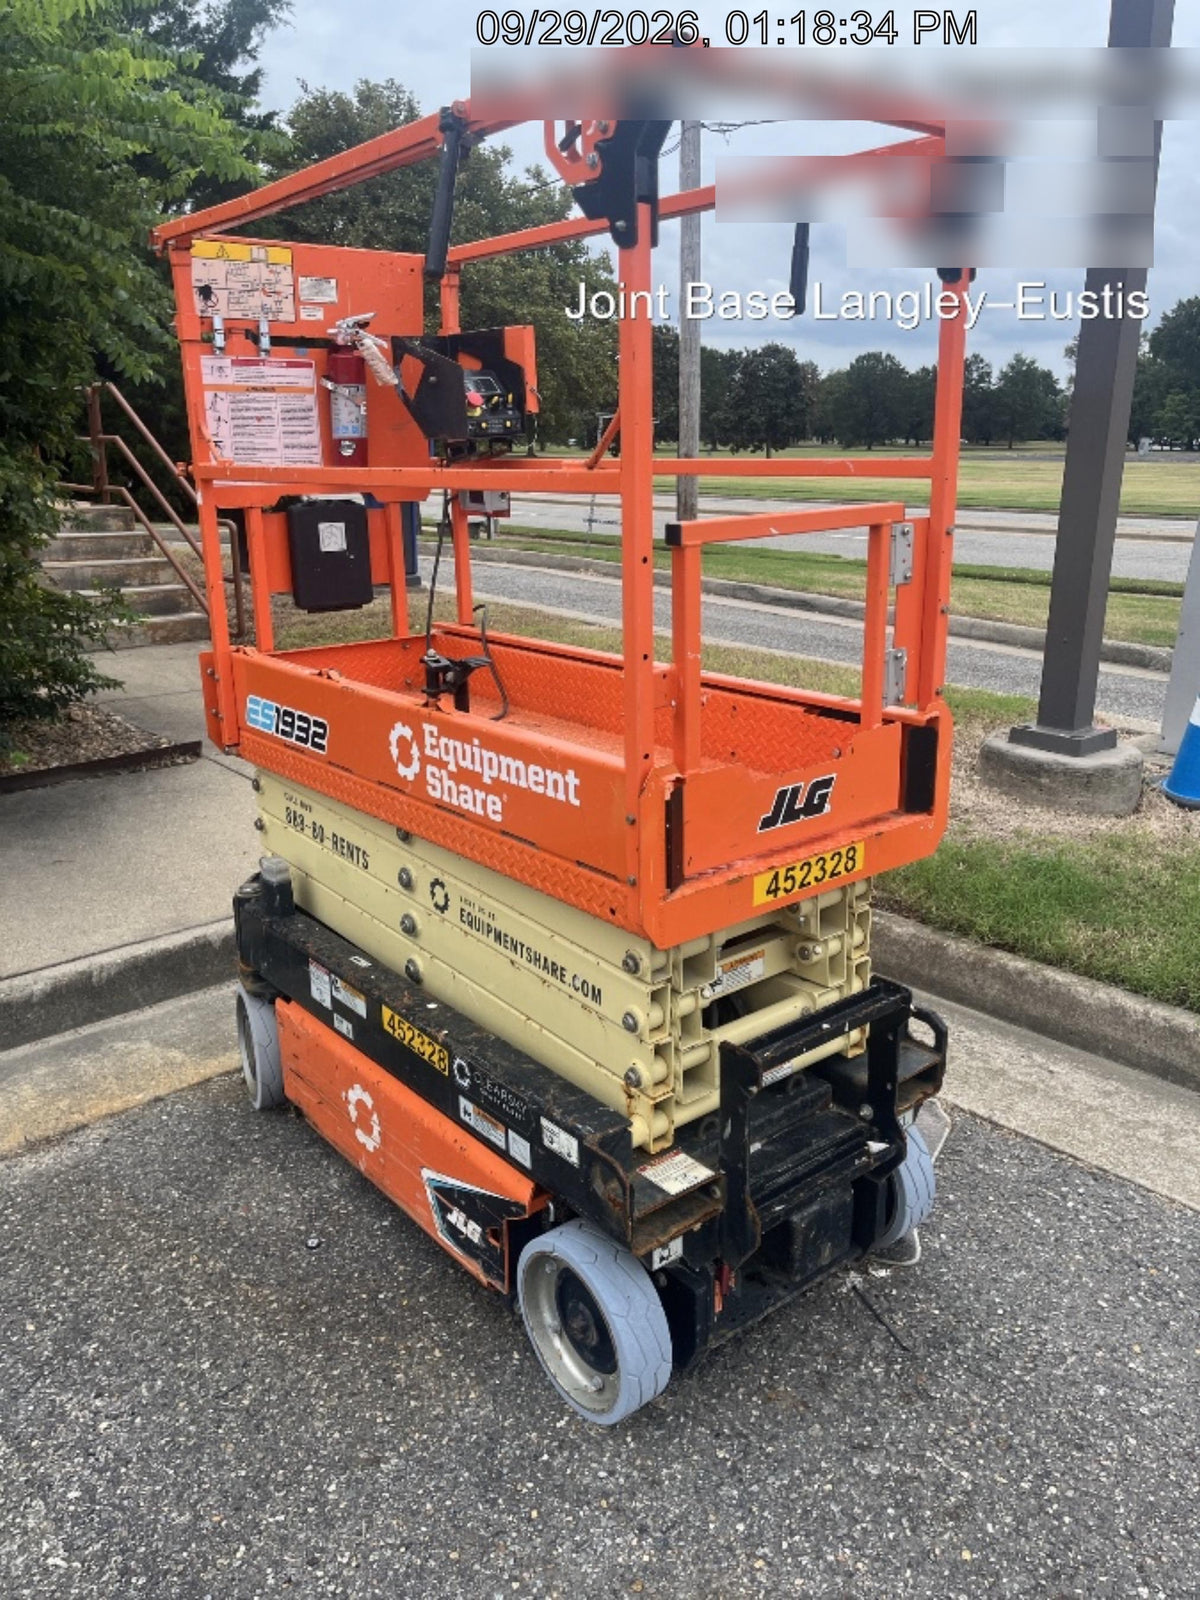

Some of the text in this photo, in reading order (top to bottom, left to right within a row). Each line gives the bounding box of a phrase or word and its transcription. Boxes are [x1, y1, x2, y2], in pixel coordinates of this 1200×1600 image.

[246, 695, 330, 755] ES1932
[422, 722, 582, 807] Equipment
[425, 764, 503, 823] Share
[756, 773, 837, 833] JLG
[765, 845, 858, 899] 452328
[459, 908, 603, 1006] EQUIPMENTSHARE.COM
[386, 1013, 448, 1072] 452328
[446, 1206, 483, 1244] JLG
